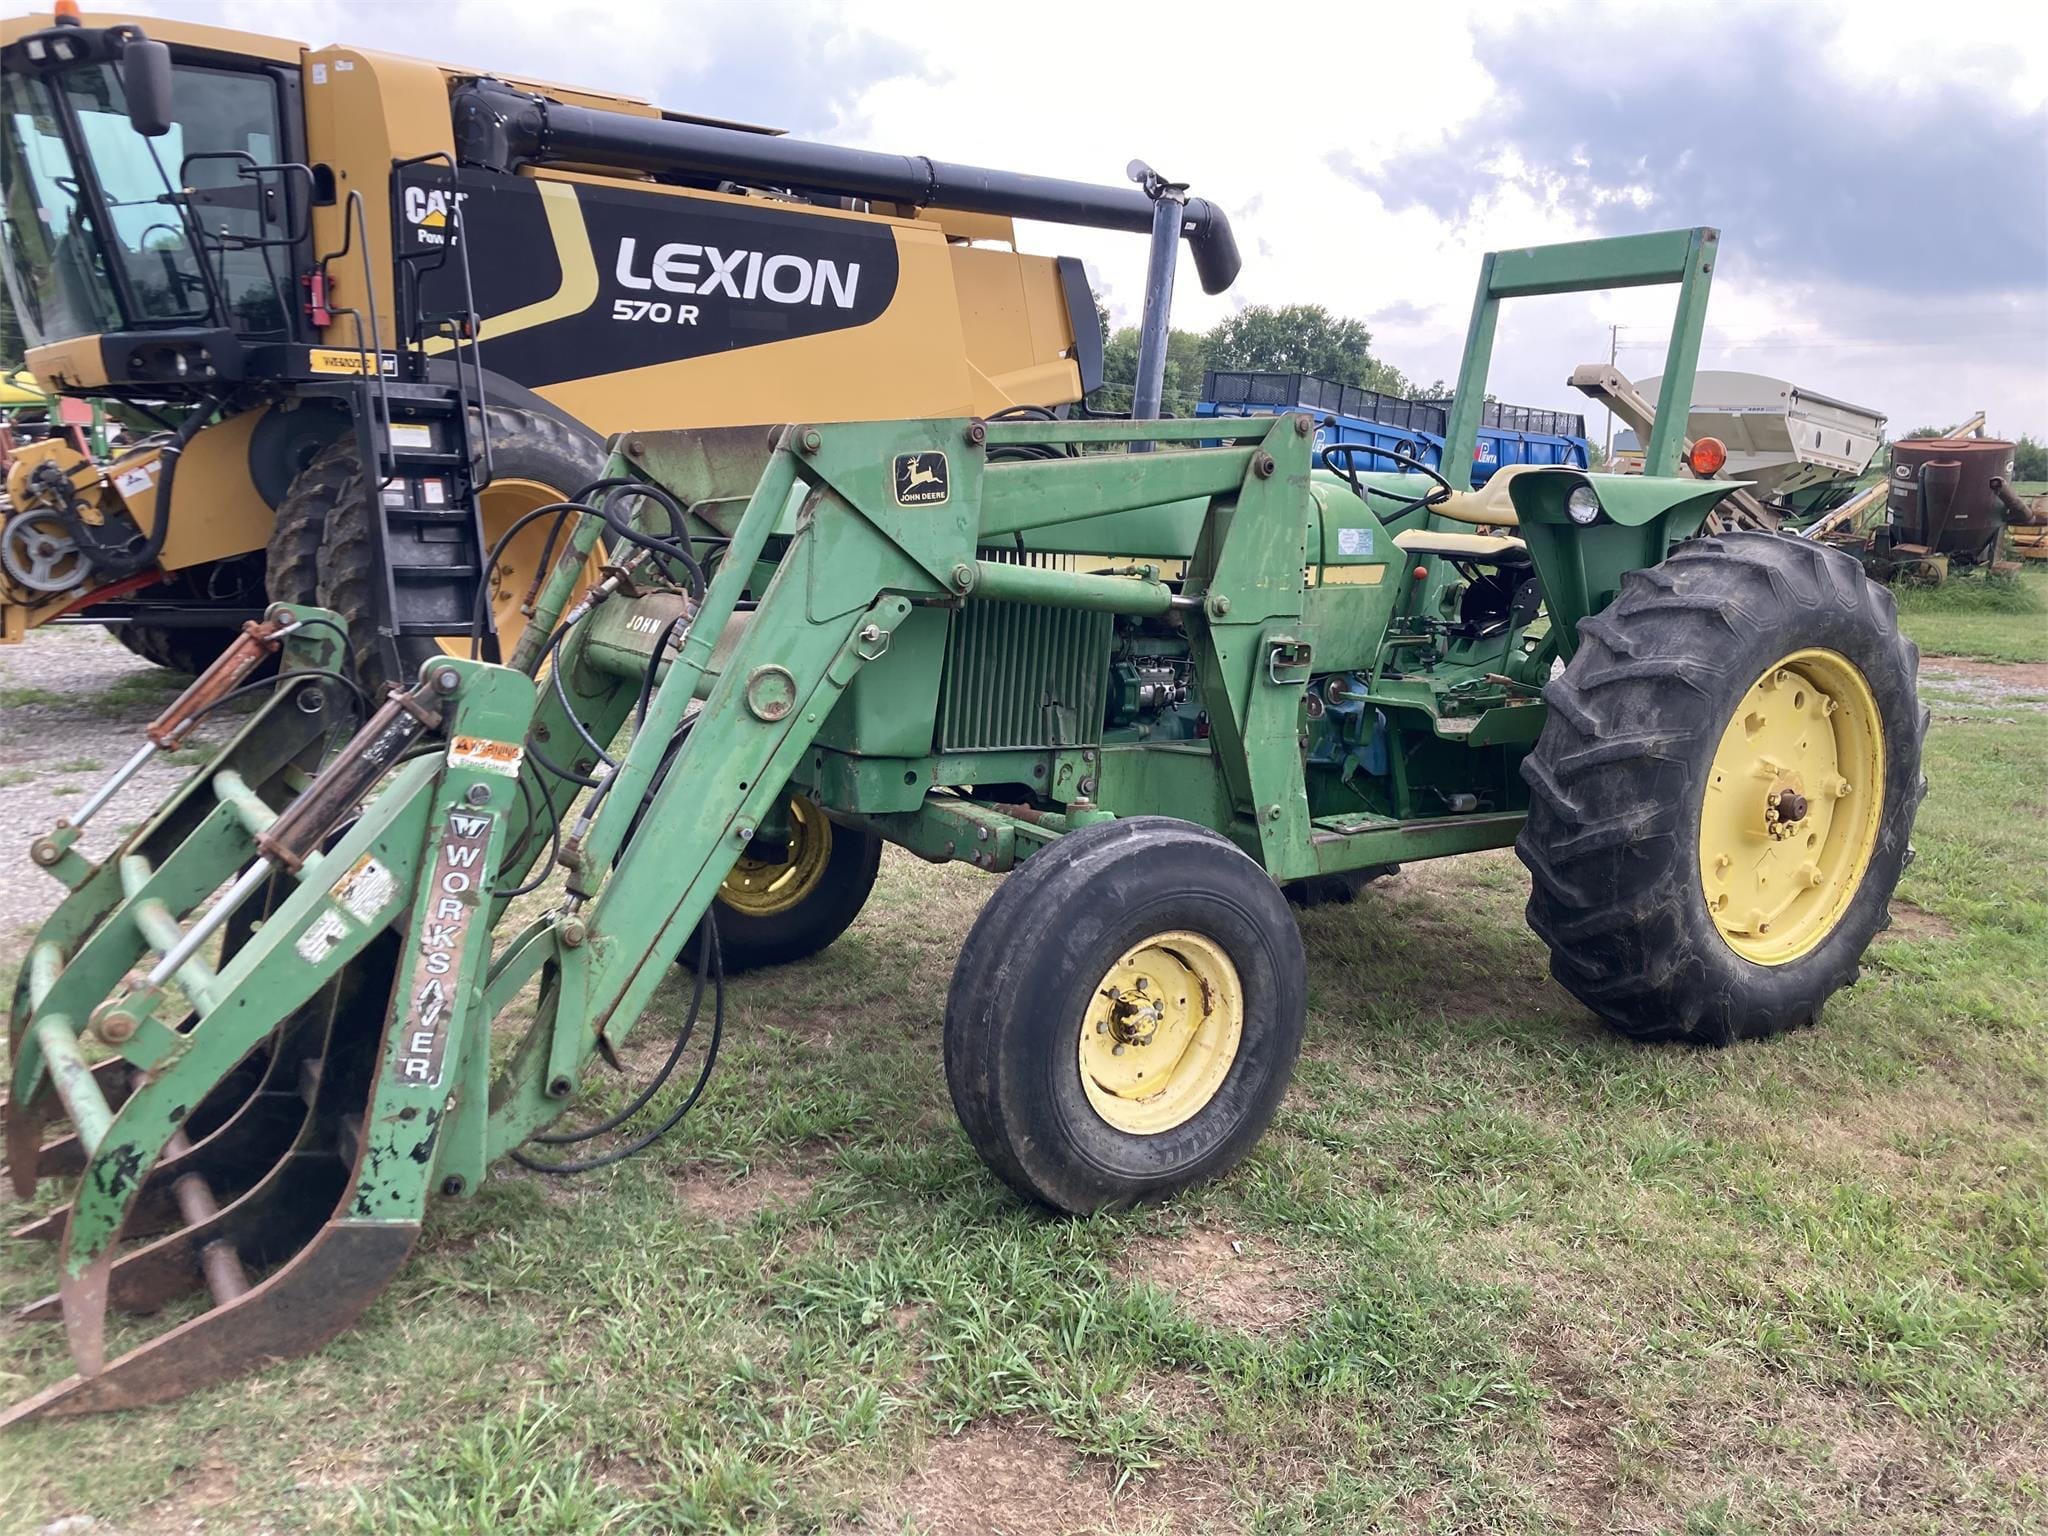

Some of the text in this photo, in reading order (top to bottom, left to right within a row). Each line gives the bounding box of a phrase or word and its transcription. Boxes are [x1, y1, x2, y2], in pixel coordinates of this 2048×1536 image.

[405, 186, 463, 227] CAT
[418, 229, 457, 246] Powr
[616, 237, 860, 309] LEXION
[612, 299, 699, 325] 570 R
[900, 491, 945, 502] JOHN DEERE
[626, 615, 661, 634] JOHN
[404, 844, 480, 1080] WORKSAVER
